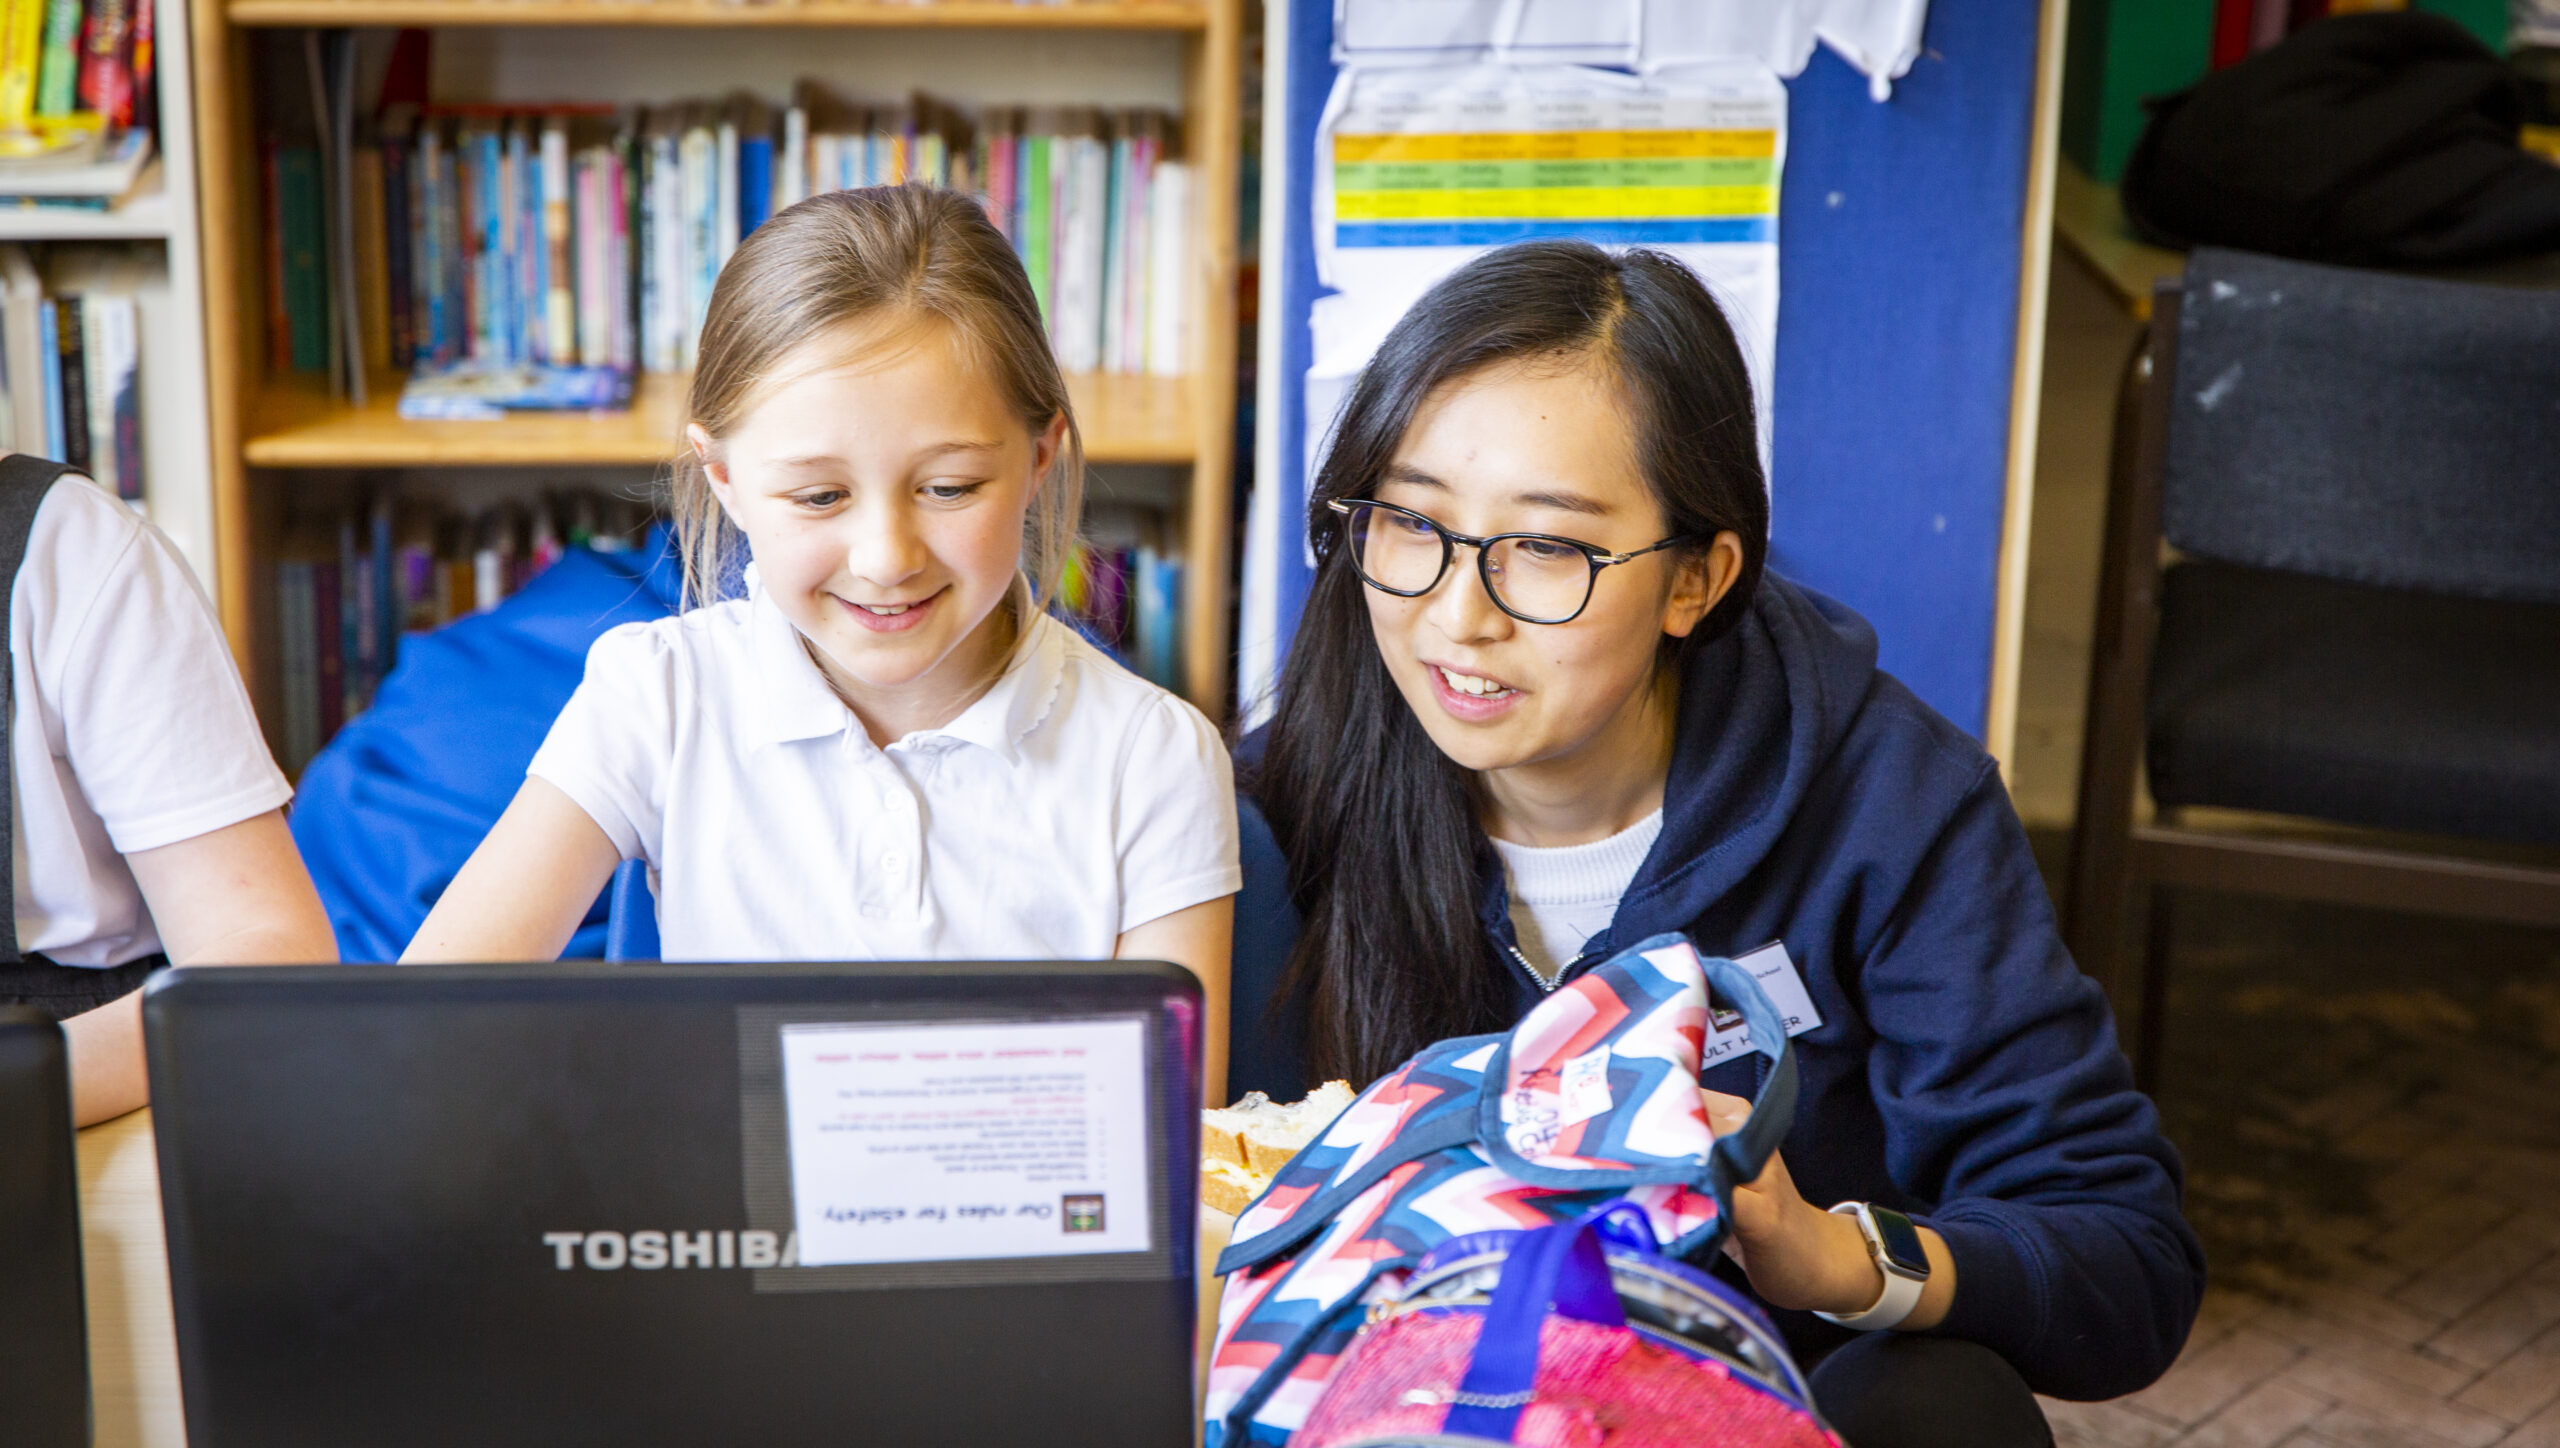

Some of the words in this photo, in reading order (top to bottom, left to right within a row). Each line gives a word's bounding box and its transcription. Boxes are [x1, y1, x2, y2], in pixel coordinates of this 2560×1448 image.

[1702, 1041, 1733, 1059] ULT
[917, 1206, 947, 1223] for
[957, 1206, 1006, 1222] rules
[1017, 1204, 1053, 1220] Our
